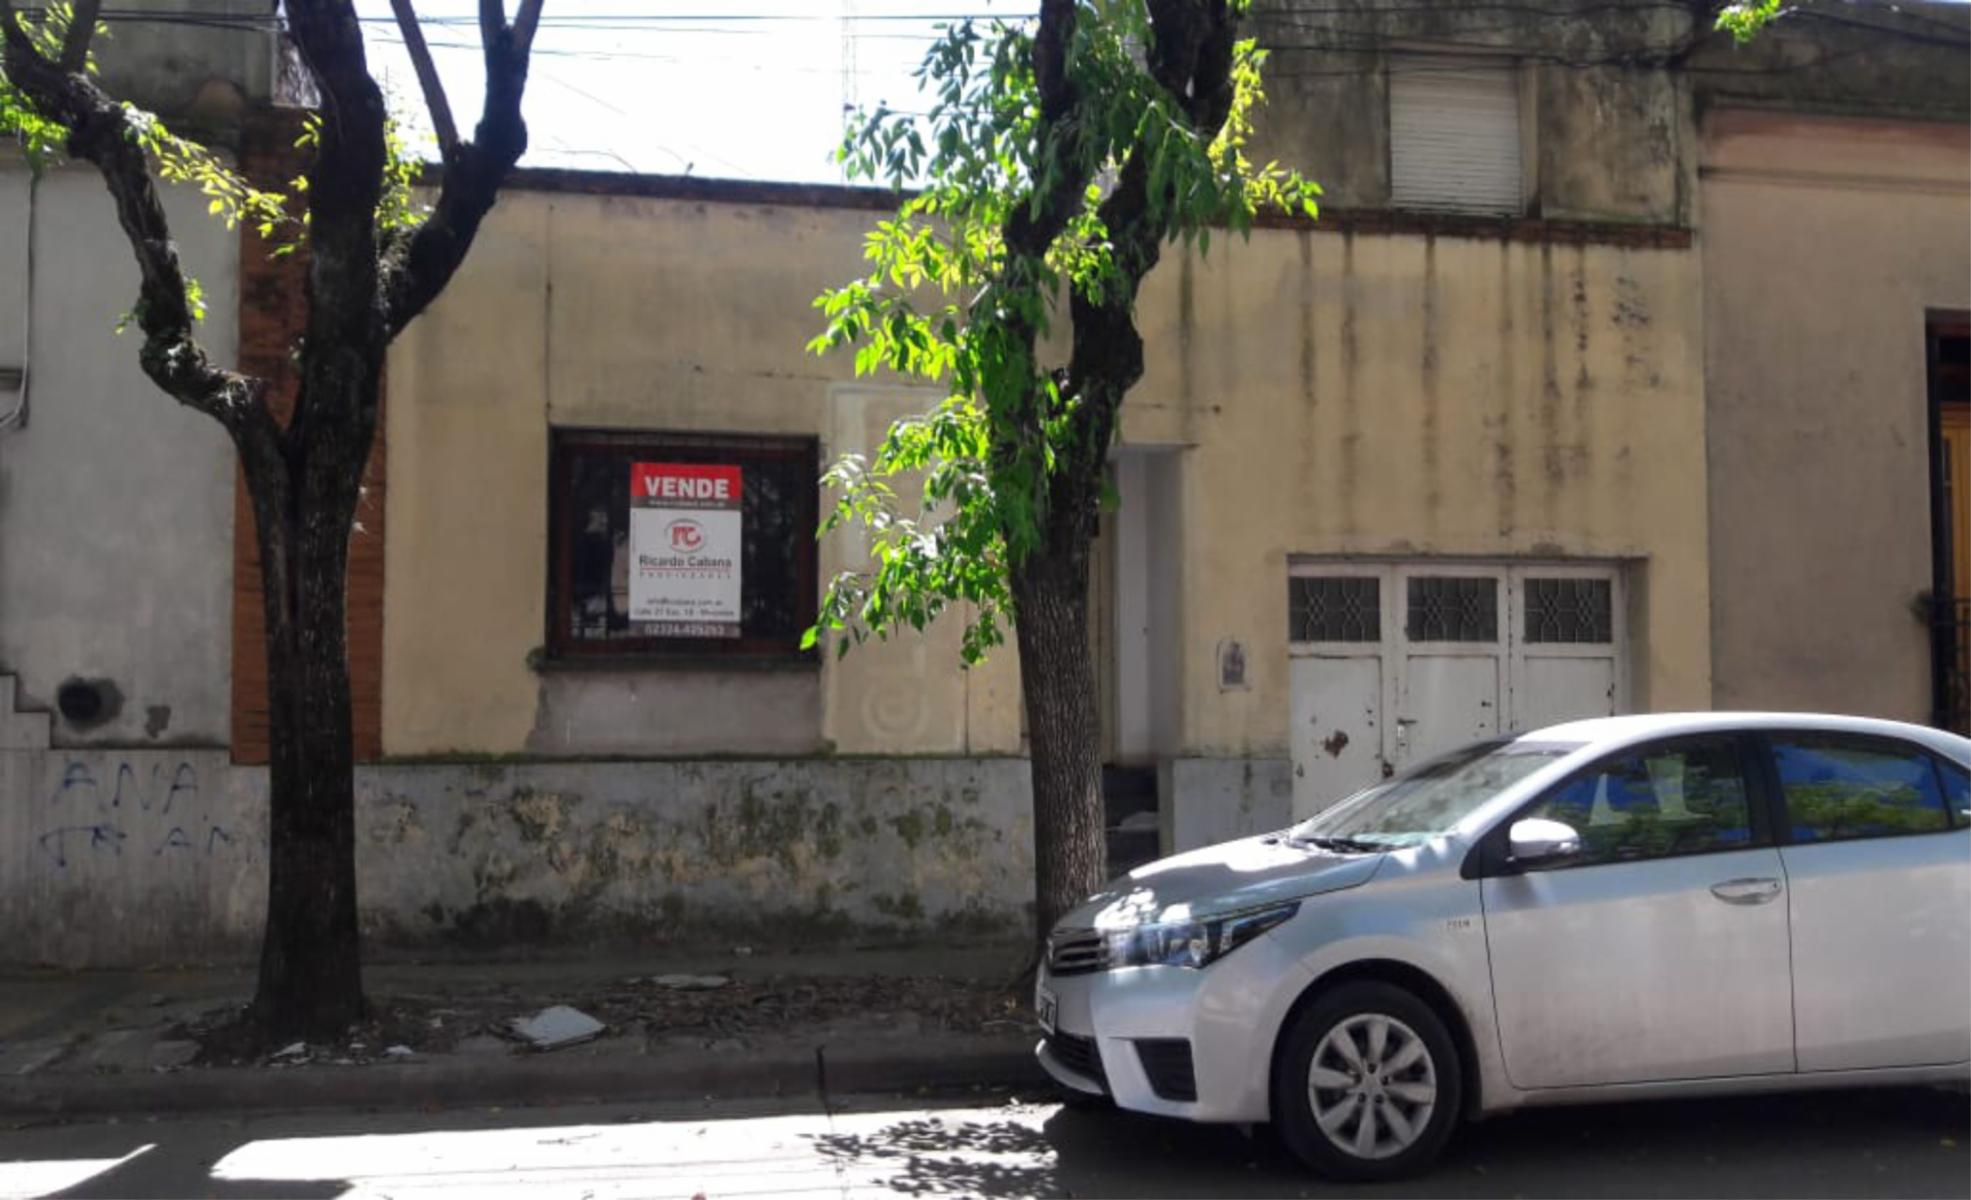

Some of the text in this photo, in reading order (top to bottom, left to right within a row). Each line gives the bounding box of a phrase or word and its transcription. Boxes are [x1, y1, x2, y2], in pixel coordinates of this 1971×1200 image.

[645, 476, 729, 499] VENDE
[639, 553, 732, 568] Ricardo Cabana
